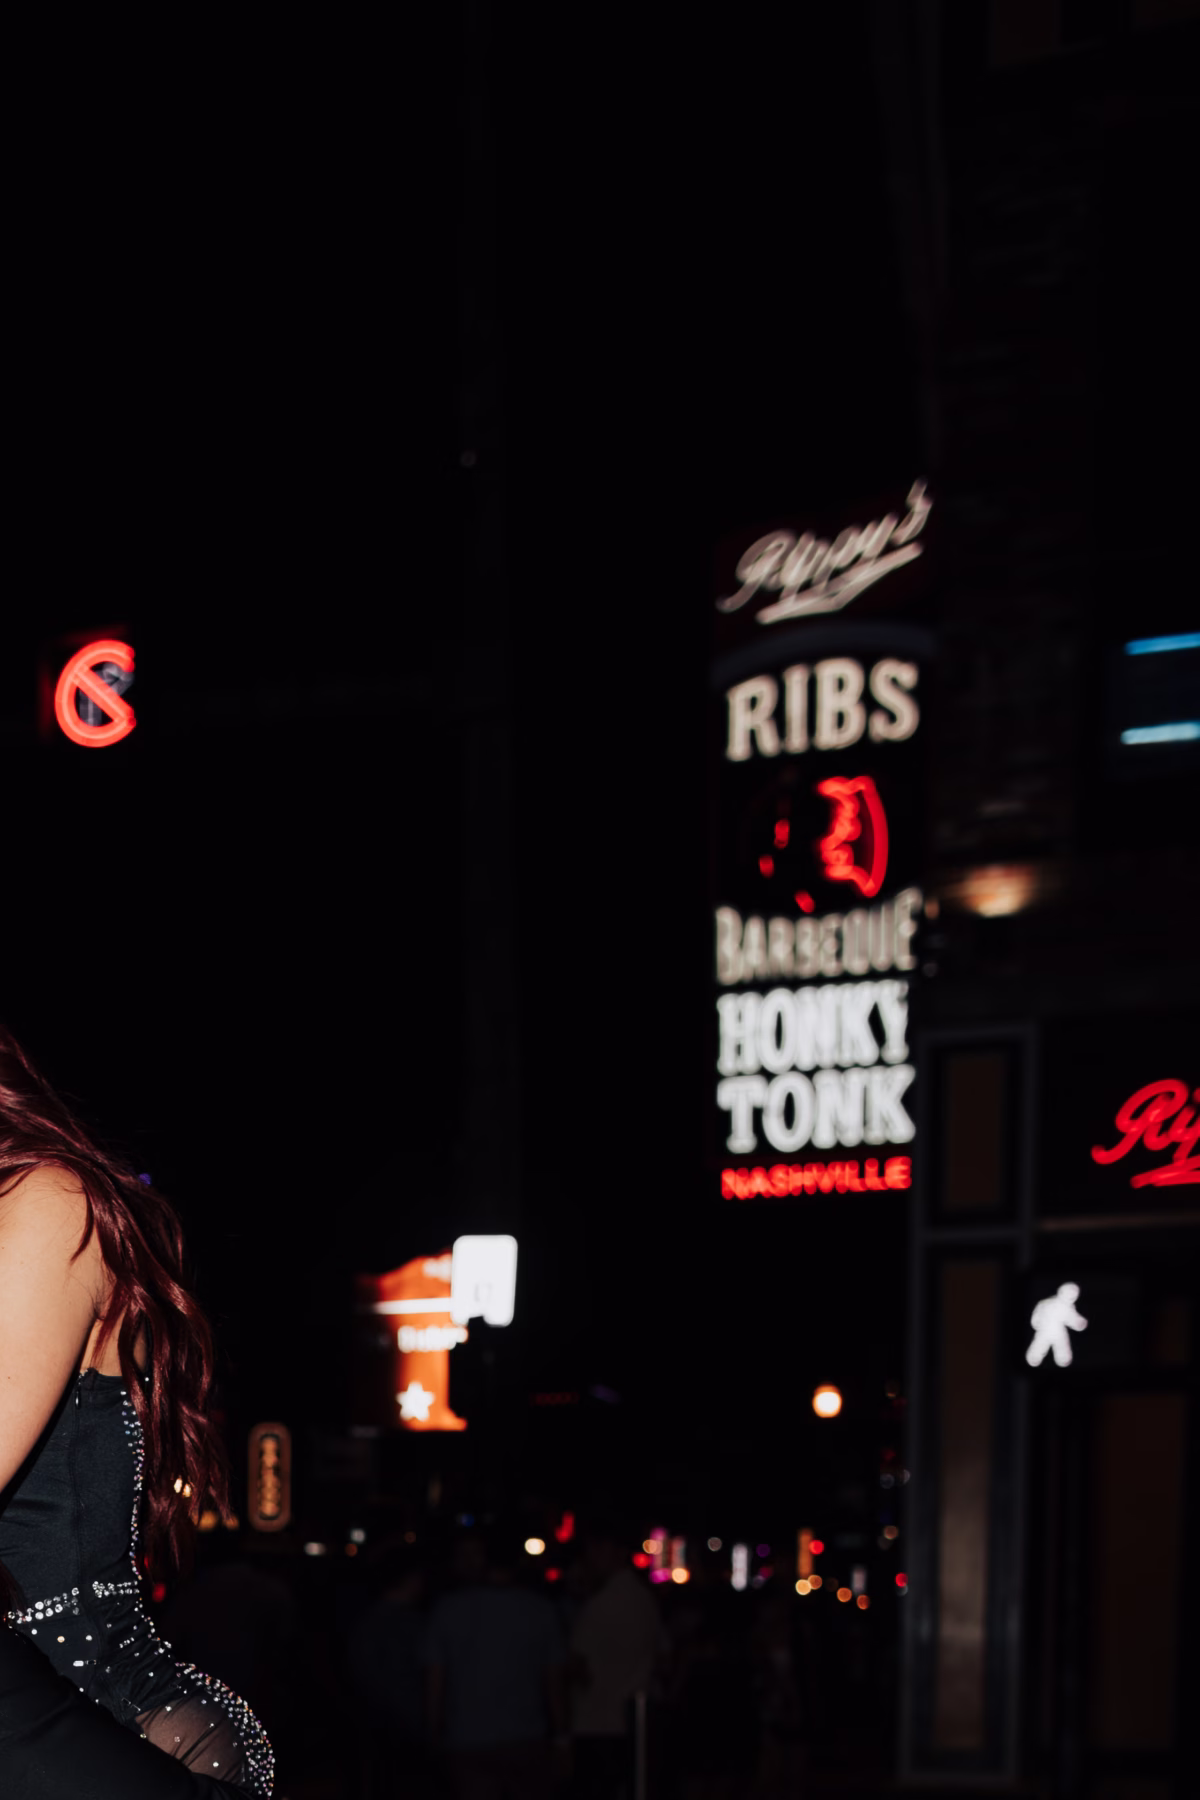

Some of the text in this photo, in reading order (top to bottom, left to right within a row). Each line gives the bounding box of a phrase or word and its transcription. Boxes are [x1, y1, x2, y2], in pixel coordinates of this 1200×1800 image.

[727, 657, 920, 761] RIBS
[717, 980, 908, 1076] HONKY
[717, 1064, 915, 1153] TONK
[721, 1157, 912, 1199] NASHVILLE
